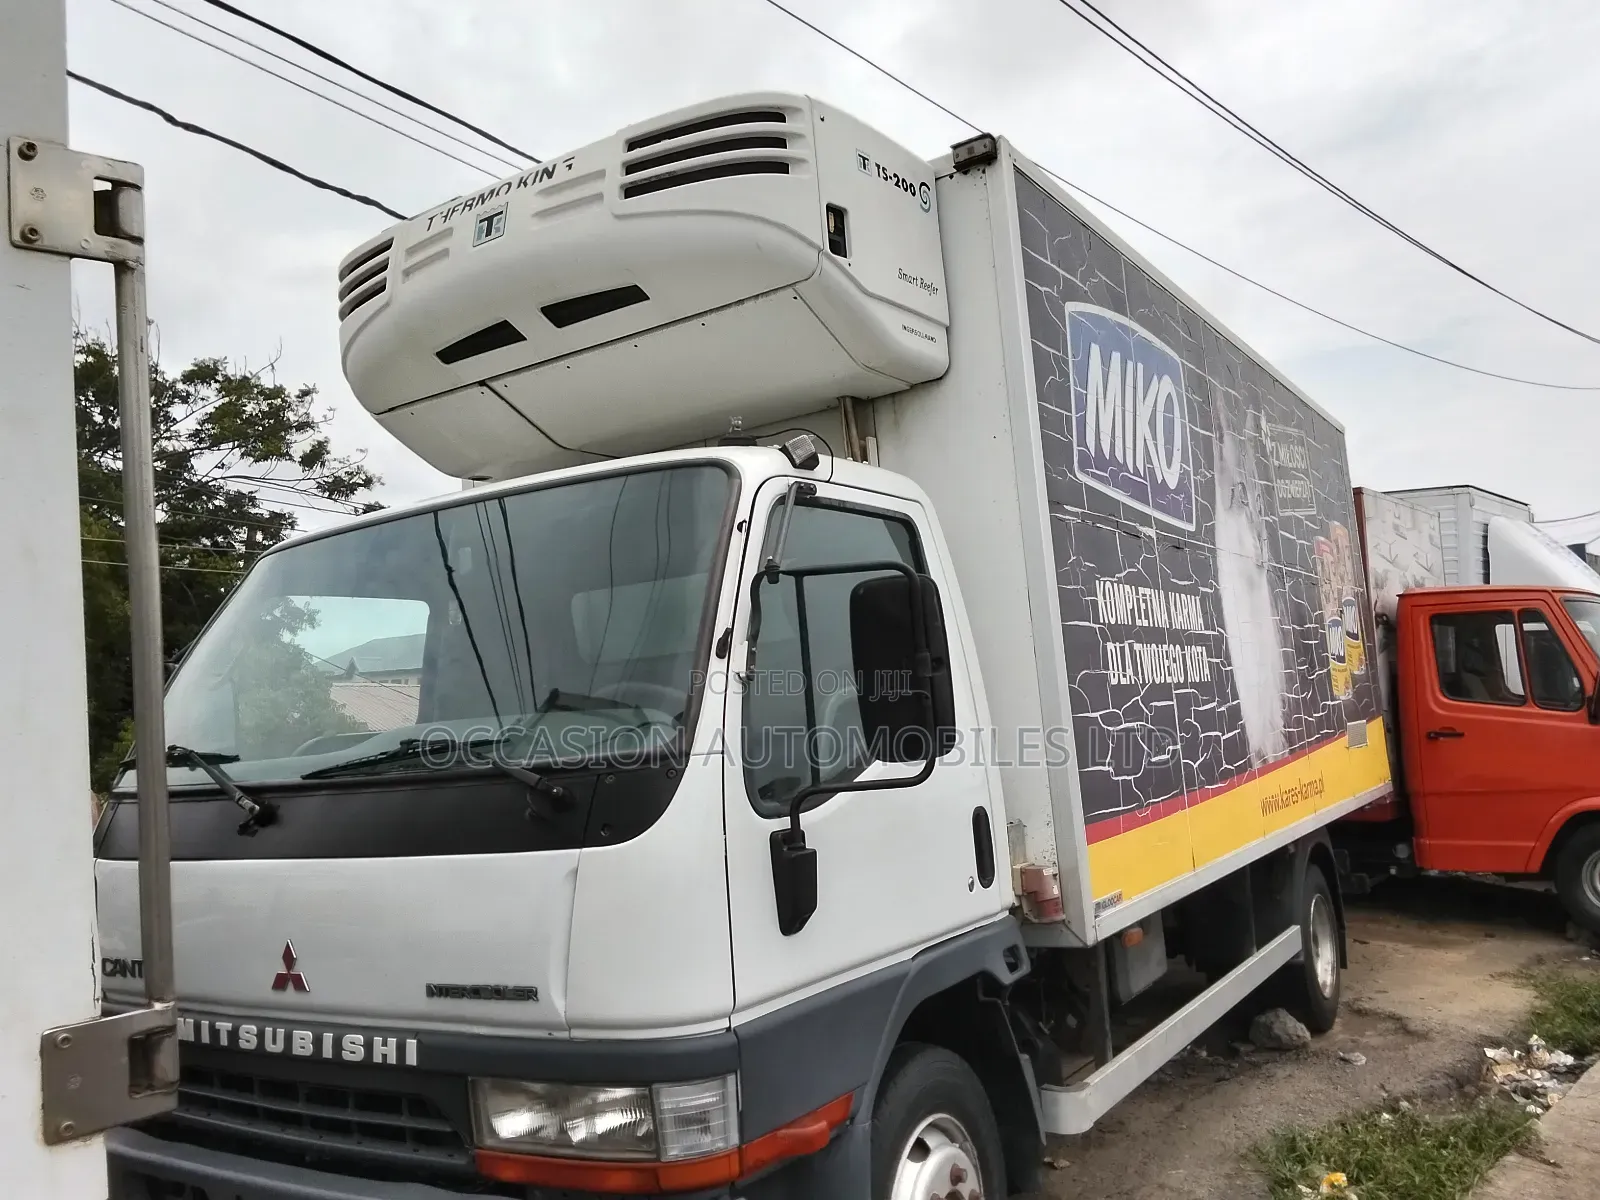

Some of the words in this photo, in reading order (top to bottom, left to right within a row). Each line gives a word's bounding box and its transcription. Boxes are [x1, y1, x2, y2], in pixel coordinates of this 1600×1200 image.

[875, 162, 916, 197] TS-200
[897, 267, 919, 287] Smart
[919, 277, 939, 296] Reefer
[1085, 342, 1182, 490] MIKO
[1095, 580, 1169, 628] KOMPLETNA
[1168, 591, 1205, 630] KARMA
[1106, 641, 1134, 685] DLA
[1133, 642, 1184, 684] TWOJEGO
[1184, 645, 1211, 682] KOTA
[1260, 769, 1325, 817] www.kares-karma.pl
[101, 957, 143, 979] CANT
[177, 1017, 419, 1067] MITSUBISHI
